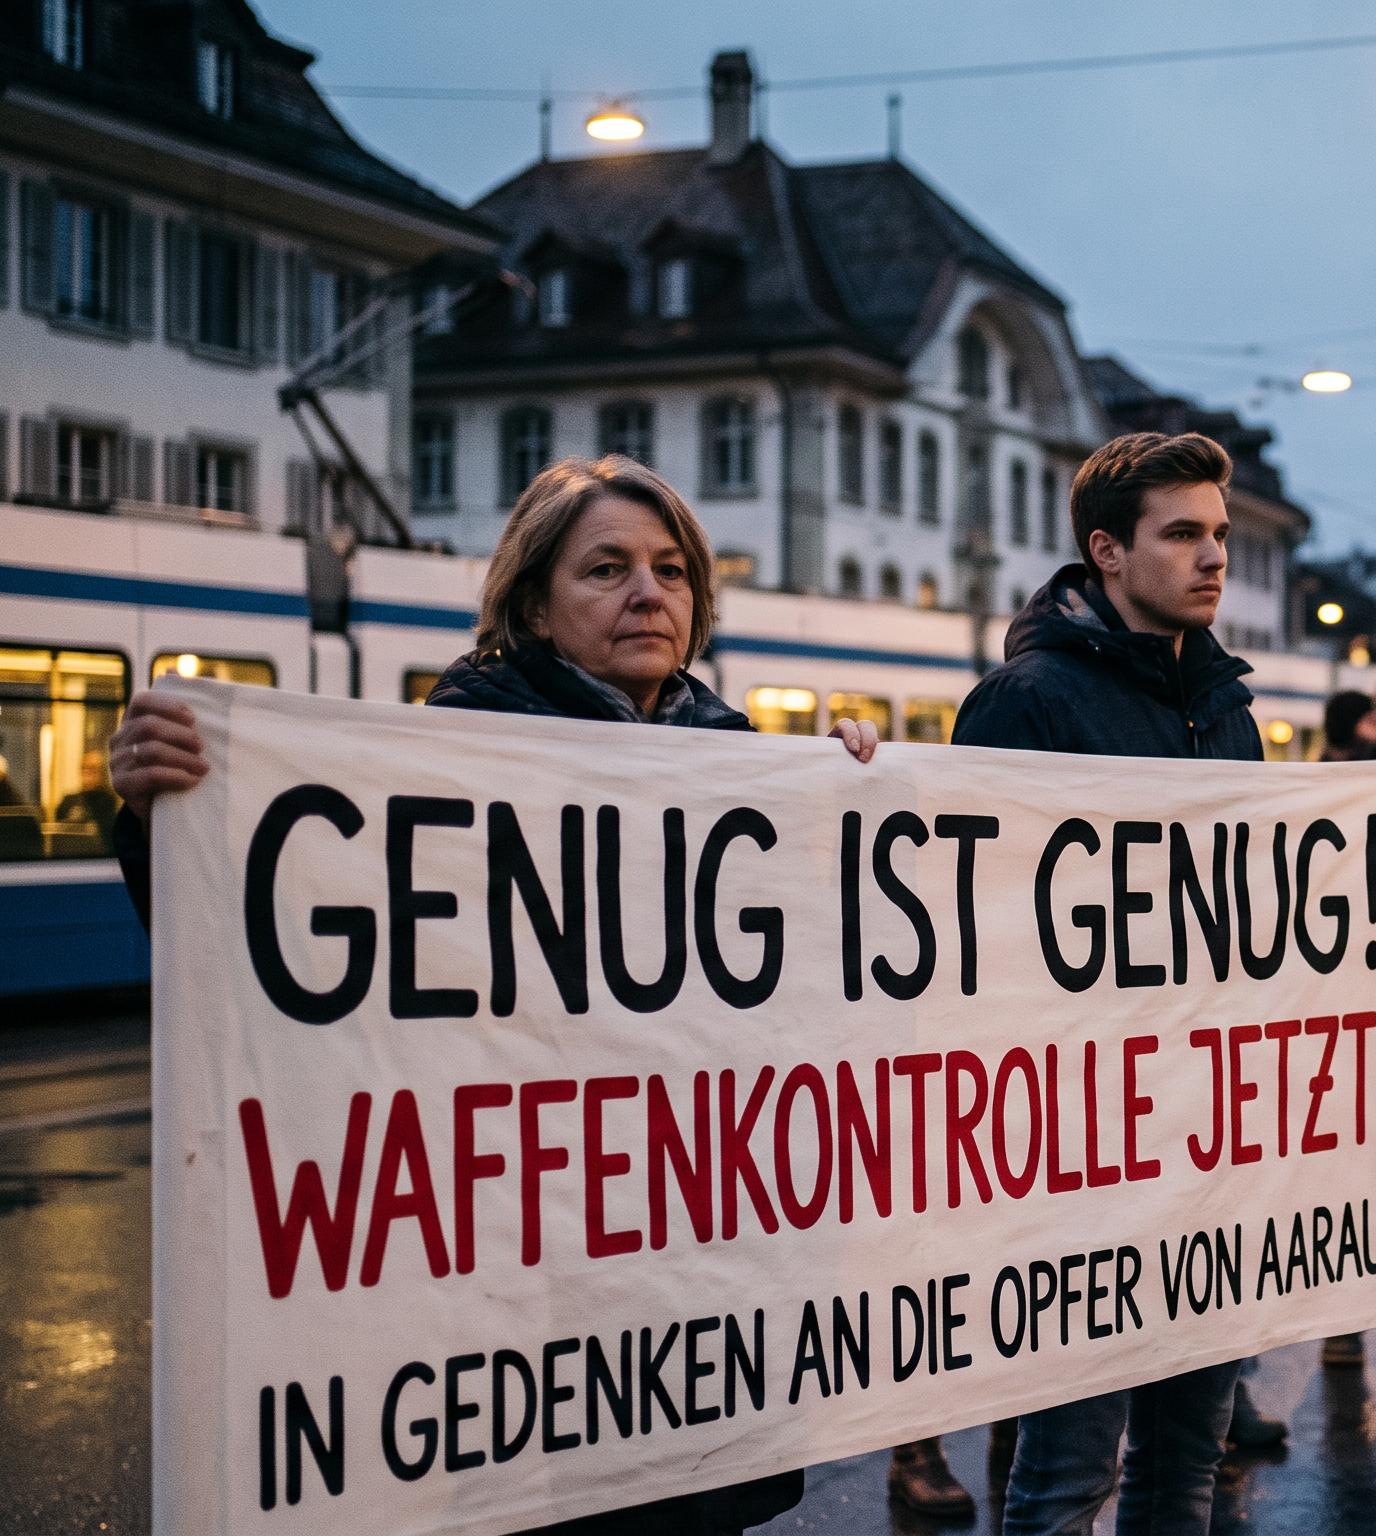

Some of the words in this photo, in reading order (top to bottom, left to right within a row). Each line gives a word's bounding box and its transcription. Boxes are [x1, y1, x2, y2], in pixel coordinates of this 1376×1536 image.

[243, 783, 784, 1026] GENUG
[840, 810, 1000, 1001] IST
[239, 1035, 1162, 1299] WAFFENKONTROLLE
[258, 1375, 345, 1512] IN
[380, 1308, 766, 1483] GEDENKEN
[788, 1291, 870, 1405] AN
[891, 1273, 973, 1383] DIE
[990, 1245, 1143, 1359] OPFER
[1159, 1223, 1242, 1321] VON
